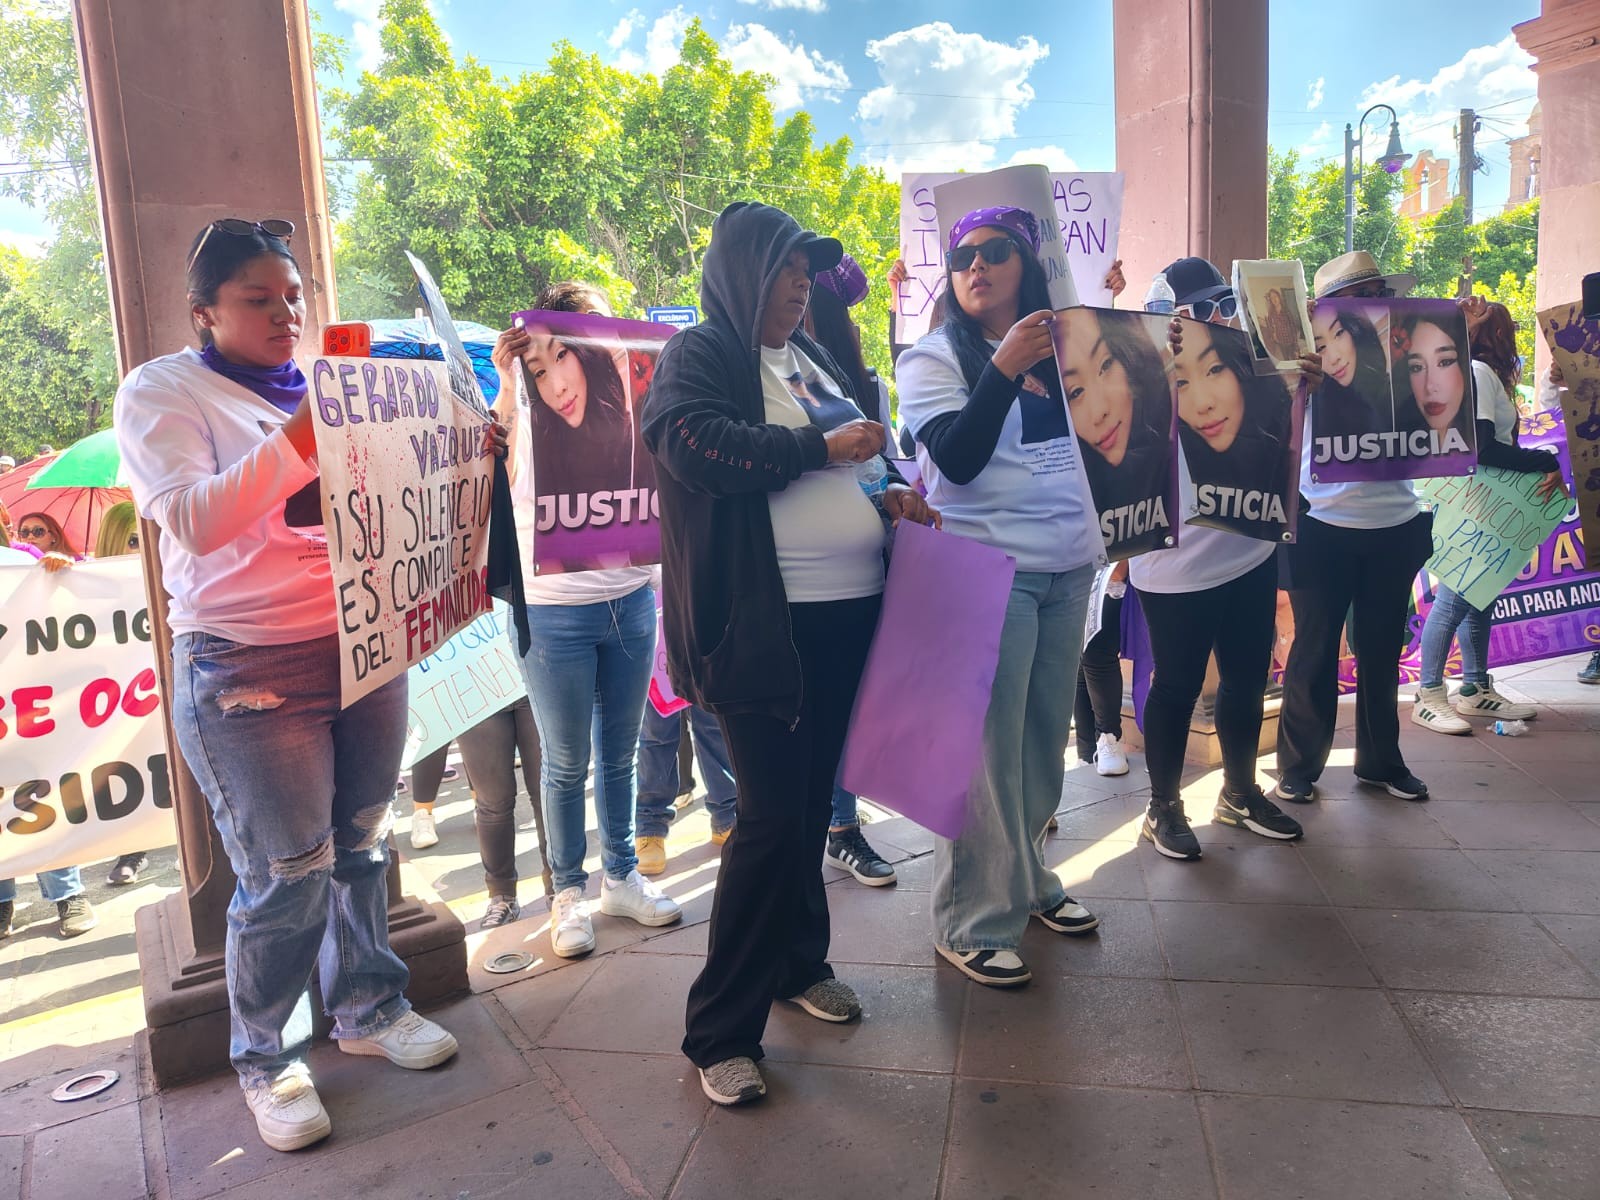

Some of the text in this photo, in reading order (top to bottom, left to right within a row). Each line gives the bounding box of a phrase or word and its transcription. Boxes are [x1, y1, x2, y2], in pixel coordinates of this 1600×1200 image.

[313, 359, 439, 427] GERARDO
[410, 423, 491, 479] VAZQUEZ
[1314, 428, 1469, 464] JUSTICIA
[402, 474, 491, 552] SILENCIO
[1192, 483, 1287, 523] STICIA
[1448, 519, 1510, 574] PARA
[339, 568, 382, 633] ES
[391, 533, 471, 613] COMPLICE
[1491, 597, 1521, 620] CIA
[1523, 588, 1567, 614] PARA
[26, 613, 96, 655] NO
[352, 631, 392, 681] DEL
[0, 753, 173, 836] SID
